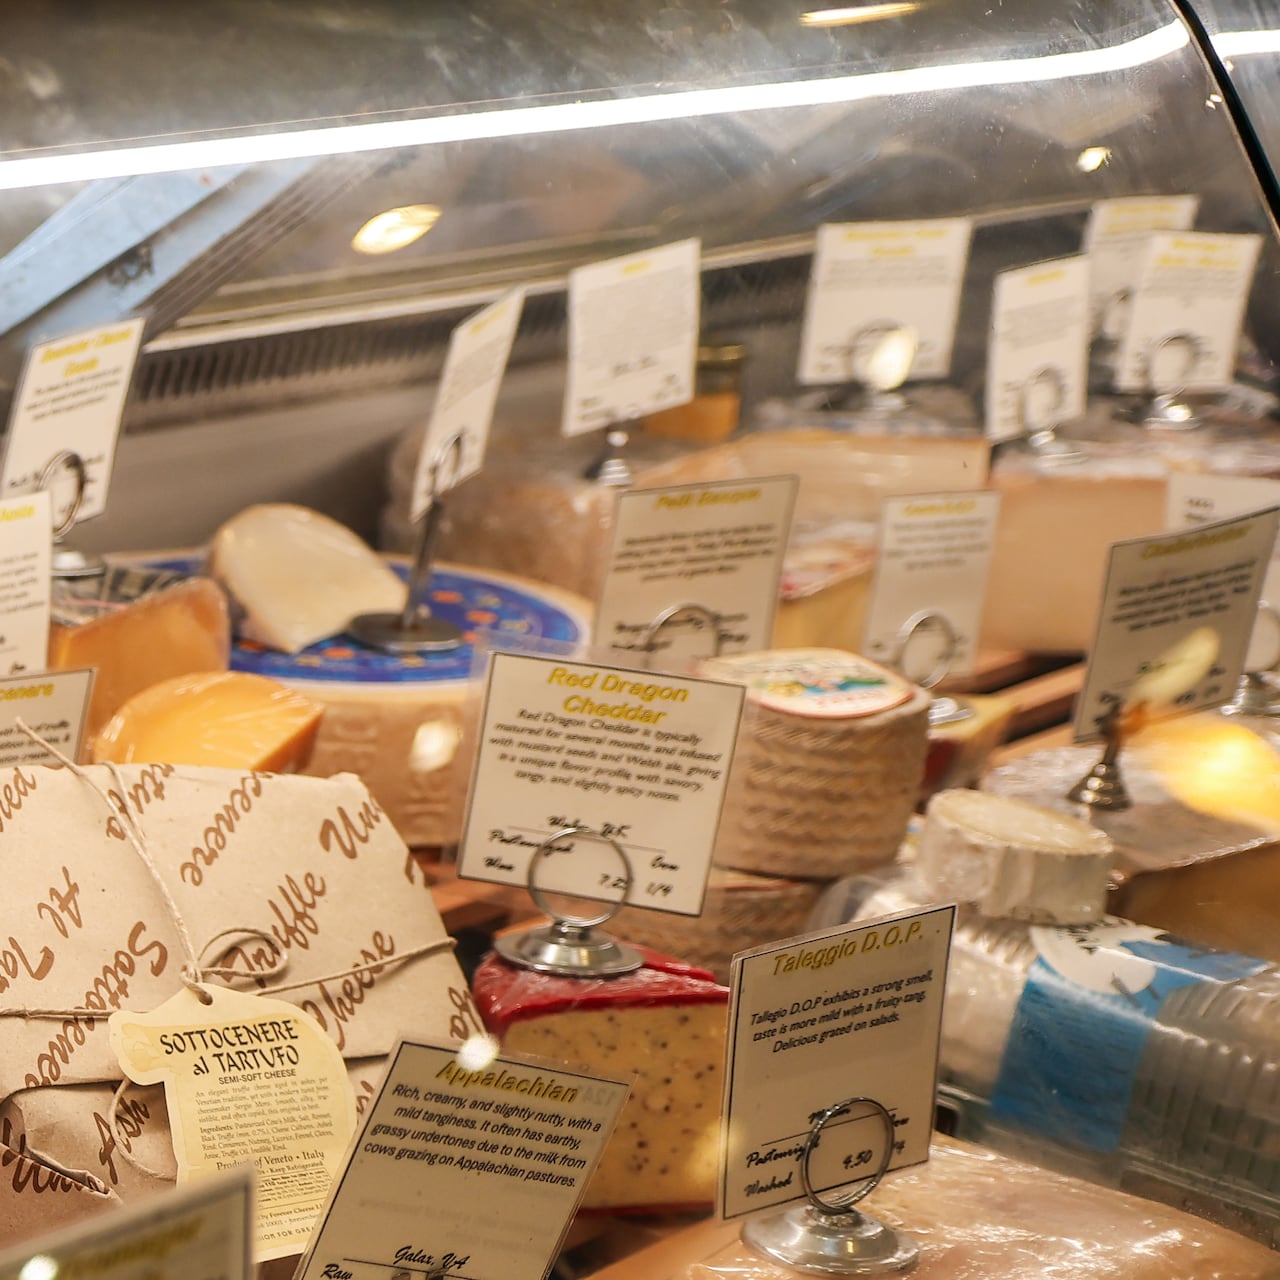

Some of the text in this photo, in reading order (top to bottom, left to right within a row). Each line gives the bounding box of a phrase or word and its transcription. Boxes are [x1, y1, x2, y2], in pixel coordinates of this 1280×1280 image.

[547, 667, 689, 702] Red Dragon
[773, 921, 924, 975] Taleggio D.O.P.
[822, 989, 861, 1006] exhibits
[862, 987, 869, 996] a
[870, 979, 904, 994] strong
[159, 1019, 300, 1056] SOTTOCENERE
[752, 1028, 777, 1042] taste
[778, 1023, 788, 1034] is
[789, 1017, 817, 1032] more
[818, 1007, 842, 1024] mild
[842, 1002, 864, 1017] with
[865, 1003, 873, 1012] a
[772, 1033, 819, 1053] Delicious
[818, 1021, 853, 1044] grated
[853, 1021, 867, 1031] on
[218, 1068, 298, 1086] SEMI-SOFT CHEESE
[435, 1061, 578, 1103] Appalachian
[391, 1083, 602, 1132] Rich, creamy, and slightly nutty, with a
[370, 1123, 586, 1169] grassy undertones due to the milk from
[393, 1106, 581, 1150] mild tanginess. It often has earthy,
[264, 1155, 295, 1167] Veneto
[302, 1150, 326, 1162] Italy
[363, 1142, 575, 1187] cows grazing on Appalachian pastures.
[320, 1263, 353, 1280] Raw
[392, 1245, 470, 1271] Galax, VA
